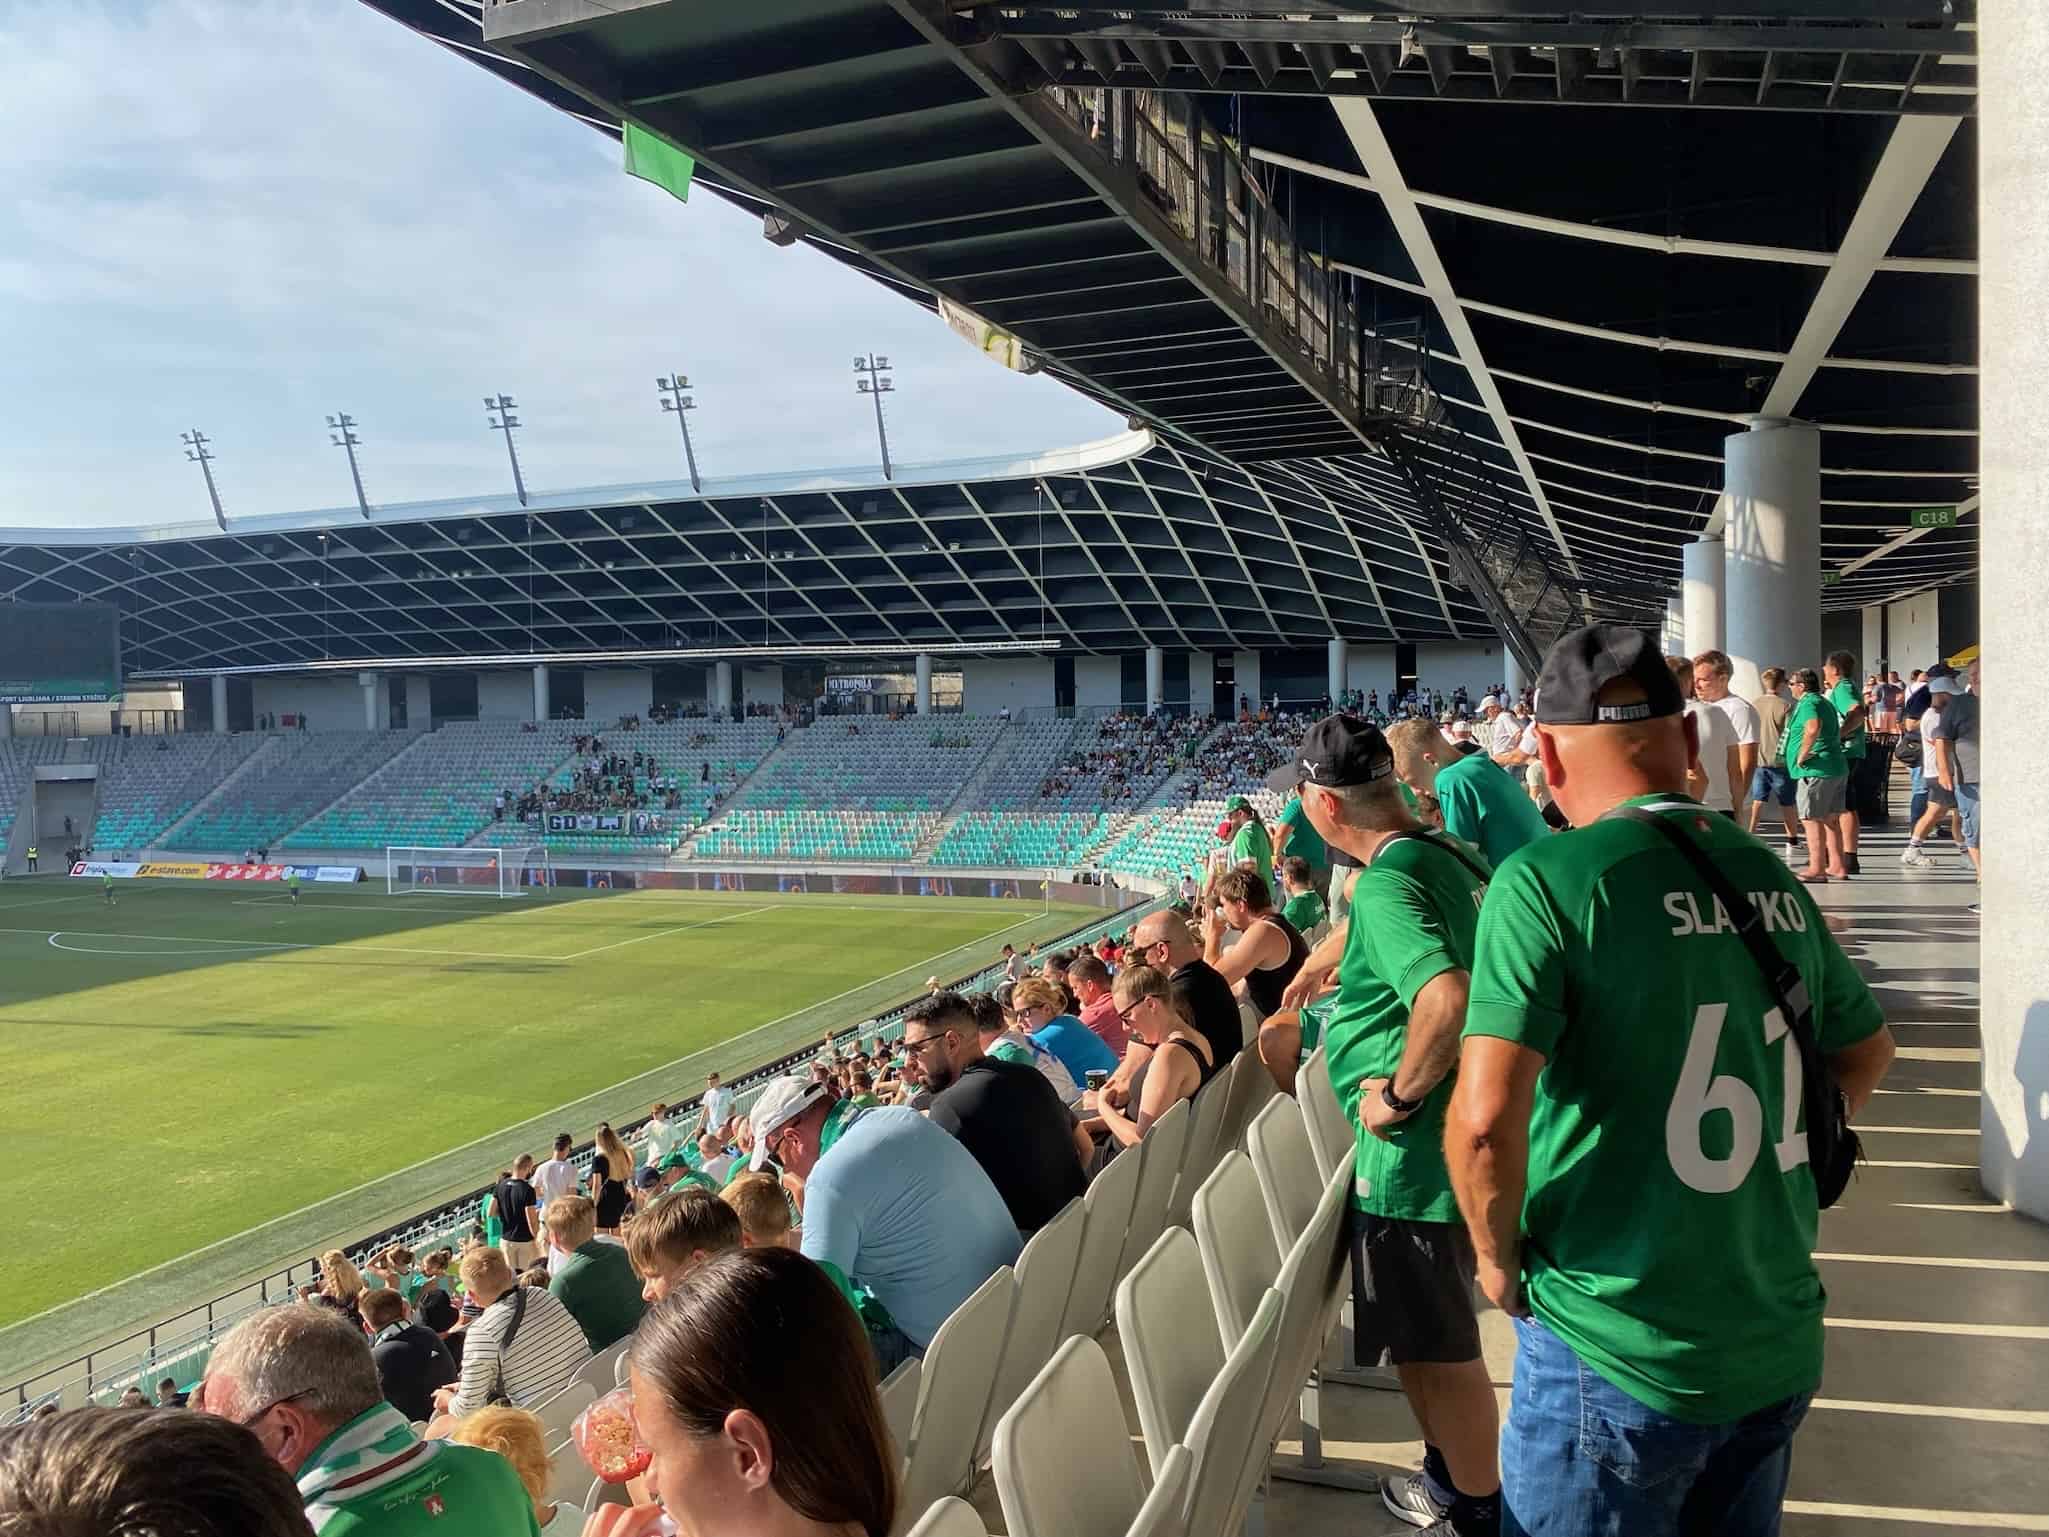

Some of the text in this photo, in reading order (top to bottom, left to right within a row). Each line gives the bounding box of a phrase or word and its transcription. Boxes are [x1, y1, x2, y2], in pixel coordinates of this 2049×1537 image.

[1920, 512, 1948, 524] C18
[1663, 891, 1807, 936] SLAKO
[1665, 1002, 1809, 1194] 61
